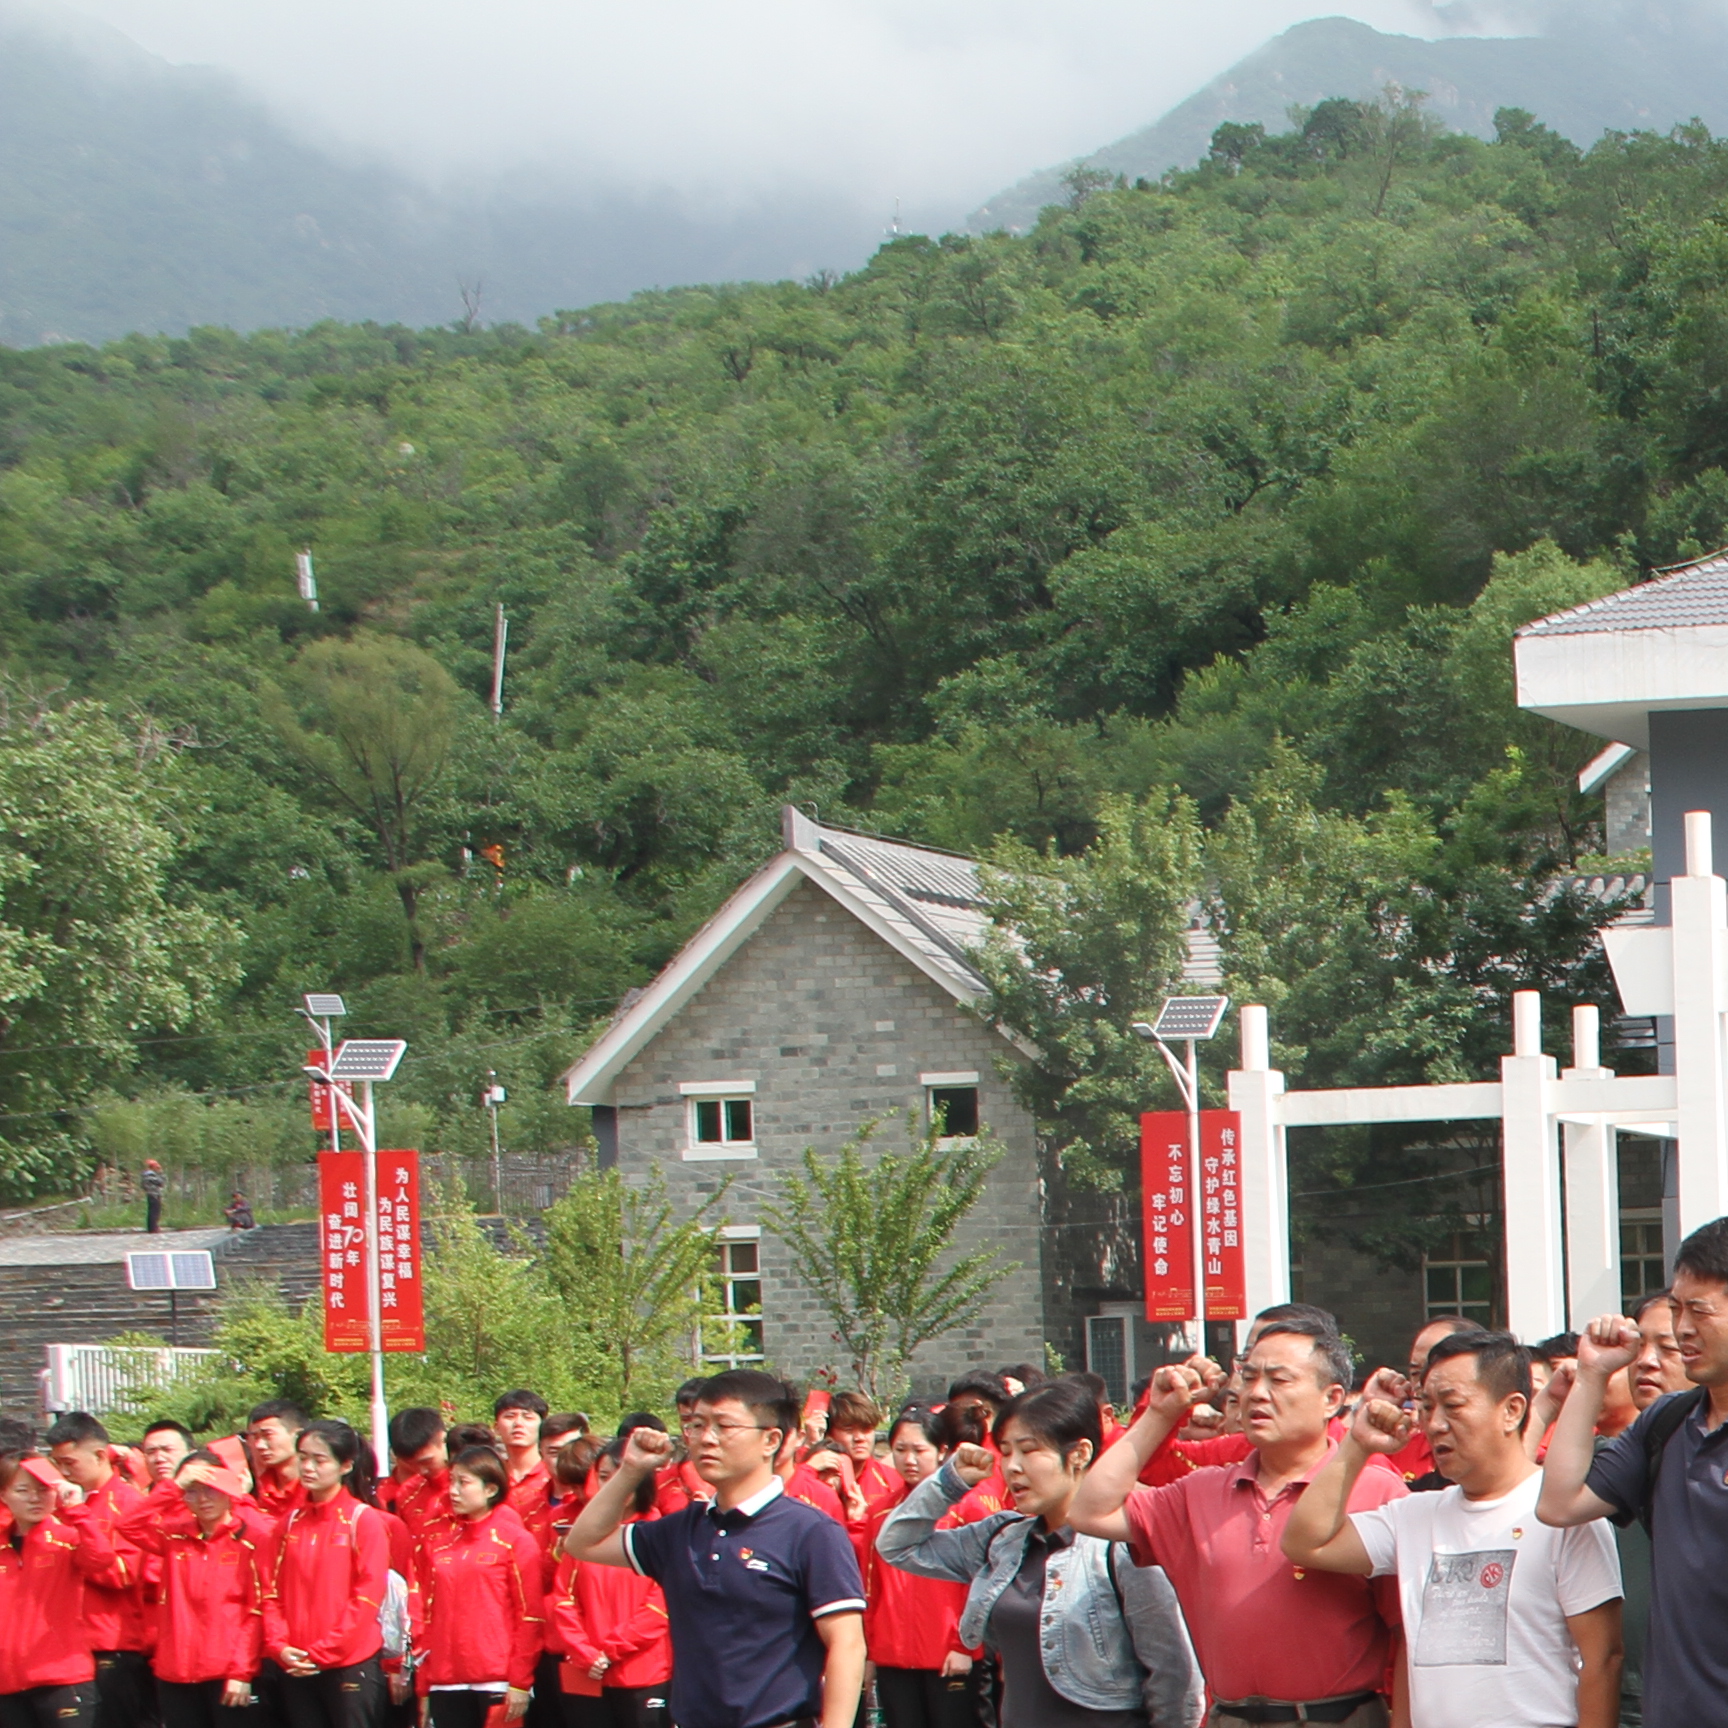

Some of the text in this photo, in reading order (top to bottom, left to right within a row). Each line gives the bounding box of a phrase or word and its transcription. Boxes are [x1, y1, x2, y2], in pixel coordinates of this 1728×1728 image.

[395, 1167, 414, 1280] 为人民谋幸福
[1151, 1193, 1170, 1277] 牢记使命
[1167, 1143, 1185, 1227] 不忘初心
[1204, 1156, 1223, 1276] 守护绿水青山
[1220, 1127, 1239, 1248] 传承红色基因
[327, 1212, 346, 1309] 奋进新时代
[379, 1196, 398, 1309] 为民族谋复兴
